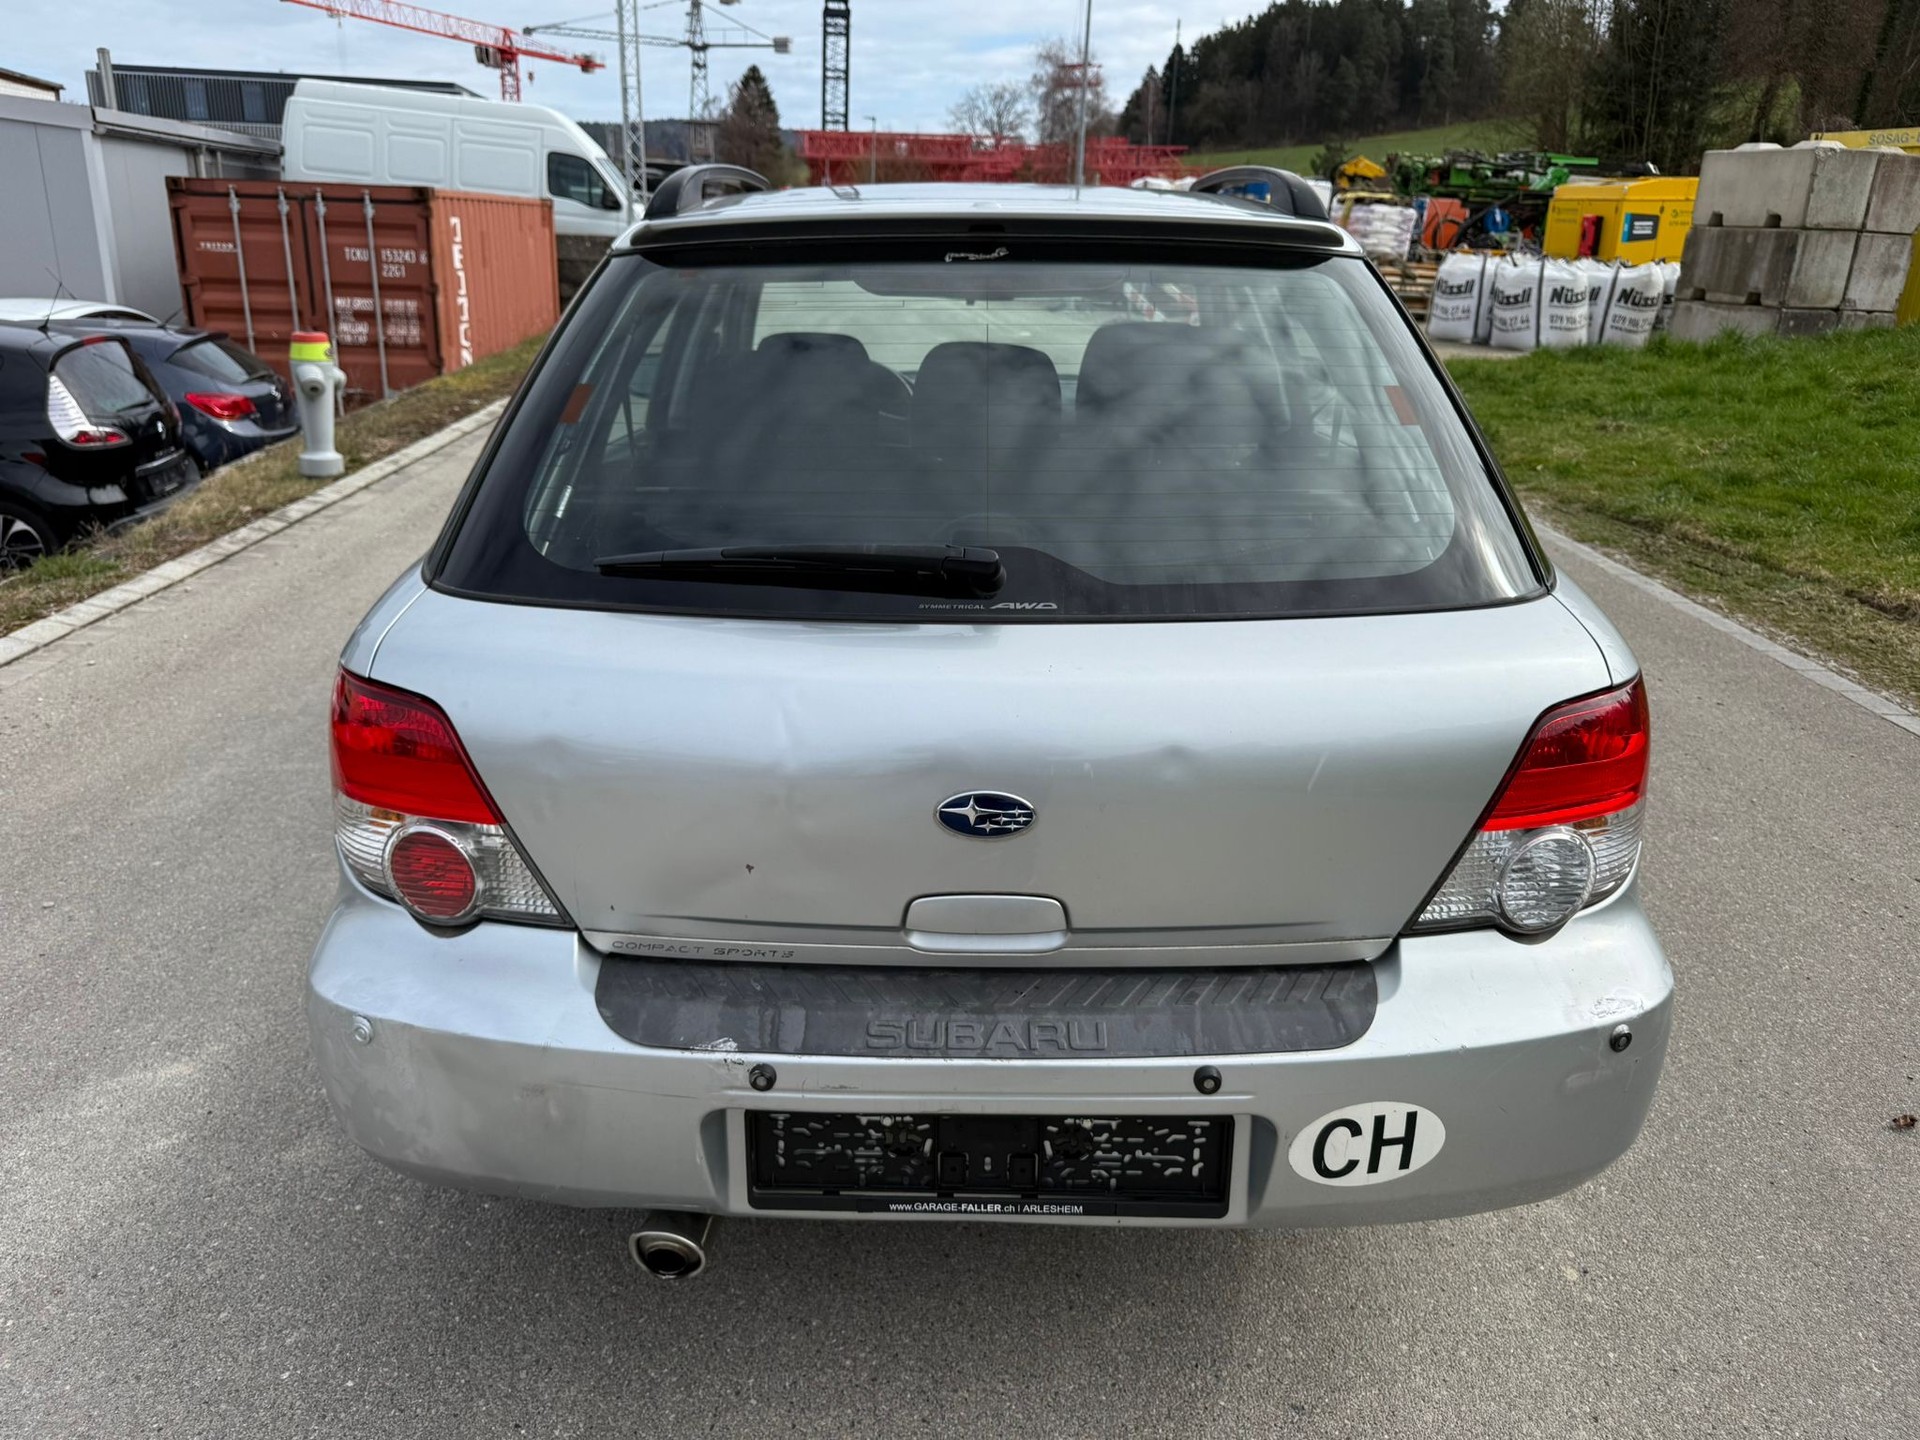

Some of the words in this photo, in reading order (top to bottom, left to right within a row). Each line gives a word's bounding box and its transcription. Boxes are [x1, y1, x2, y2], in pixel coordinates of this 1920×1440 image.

[1868, 130, 1920, 145] SOSAG-
[918, 603, 985, 611] SYMMETRICAL
[989, 602, 1058, 610] AWD
[611, 939, 705, 955] COMPACT
[866, 1019, 1108, 1051] SUBARU
[1312, 1110, 1418, 1179] CH
[889, 1201, 1015, 1213] www.GARAGE-FALLER.ch
[1022, 1203, 1084, 1214] ARLESHEIM
